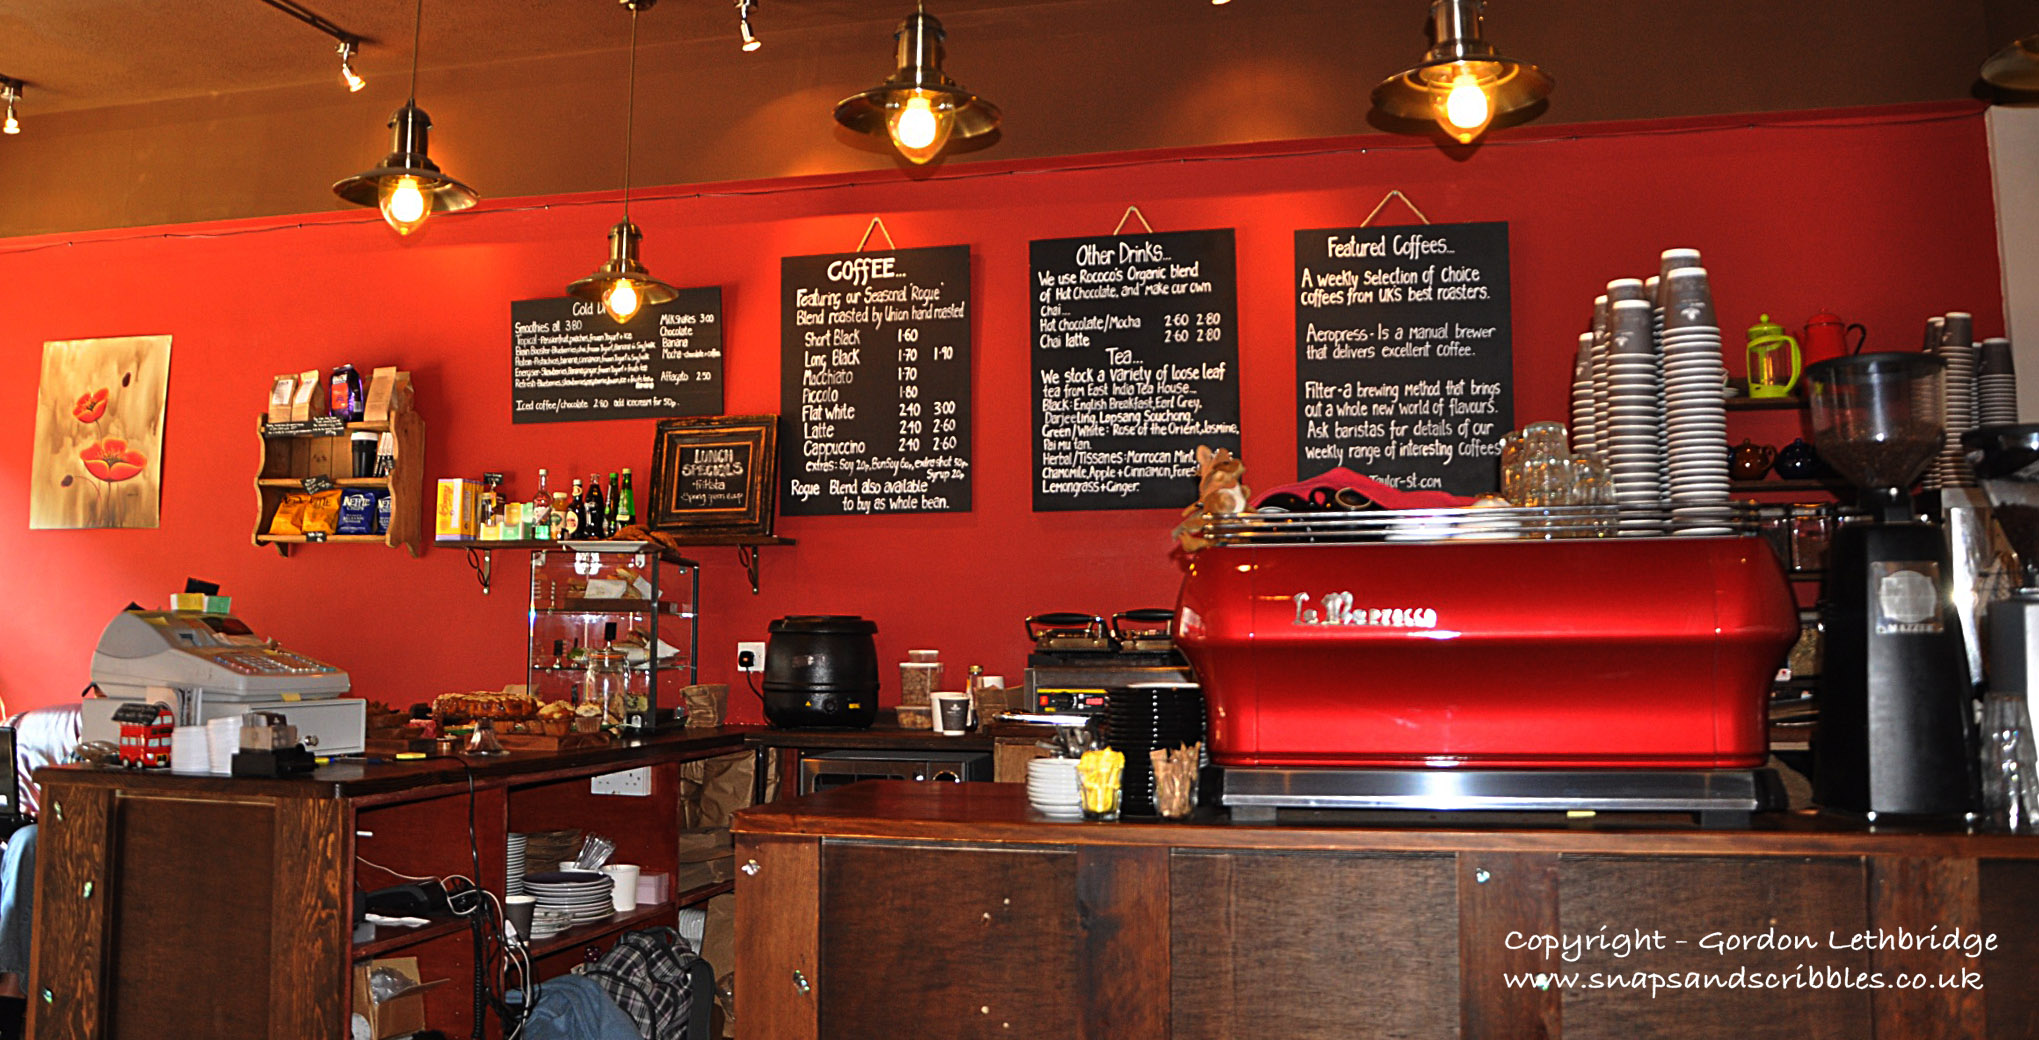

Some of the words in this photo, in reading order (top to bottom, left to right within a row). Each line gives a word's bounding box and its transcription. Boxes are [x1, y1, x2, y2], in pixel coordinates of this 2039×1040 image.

[1076, 244, 1115, 266] Other
[1327, 235, 1386, 258] Featured
[1038, 270, 1055, 286] We
[1058, 273, 1077, 285] use
[1080, 267, 1123, 284] Rococo's
[1127, 266, 1167, 286] Organic
[1170, 260, 1199, 279] blend
[1301, 267, 1313, 288] A
[1317, 269, 1358, 293] weekly
[1422, 264, 1435, 285] of
[796, 288, 841, 310] Featuring
[846, 291, 861, 304] our
[864, 286, 906, 304] Seasonal
[1039, 288, 1052, 304] of
[1055, 286, 1071, 300] Hot
[1121, 281, 1140, 297] and
[1171, 282, 1188, 294] our
[1189, 281, 1212, 294] own
[1347, 287, 1373, 306] from
[1408, 284, 1433, 302] best
[1437, 283, 1491, 301] roasters.
[572, 302, 593, 316] Cold
[797, 308, 824, 326] Blend
[828, 307, 869, 325] roasted
[872, 306, 882, 330] by
[885, 305, 909, 321] Union
[912, 303, 933, 320] hand
[934, 301, 965, 319] roasted
[660, 326, 694, 337] Chocolate
[1039, 318, 1056, 332] Hot
[1378, 322, 1389, 340] Is
[1394, 326, 1404, 340] a
[1455, 322, 1496, 338] brewer
[662, 338, 689, 348] Banana
[805, 329, 831, 347] Short
[833, 328, 860, 346] Black
[1039, 334, 1062, 348] Chai
[1065, 331, 1090, 347] latte
[1306, 343, 1328, 360] that
[1332, 343, 1375, 359] delivers
[1381, 341, 1431, 357] excellent
[805, 350, 826, 374] Long
[832, 348, 860, 366] Black
[803, 368, 853, 386] Macchiato
[1041, 369, 1060, 384] We
[1064, 367, 1094, 383] stock
[1097, 369, 1105, 382] a
[1156, 364, 1169, 386] of
[1171, 364, 1200, 381] loose
[1202, 361, 1226, 381] leaf
[803, 387, 839, 404] Piccolo
[1042, 384, 1061, 397] tea
[1087, 382, 1109, 396] East
[1112, 382, 1135, 396] India
[1135, 383, 1154, 395] Tea
[1356, 381, 1399, 403] brewing
[1446, 379, 1466, 395] that
[1471, 379, 1501, 400] brings
[516, 400, 534, 411] Iced
[802, 405, 823, 422] Flat
[825, 403, 855, 420] white
[1073, 397, 1107, 414] English
[1305, 401, 1322, 417] out
[1325, 403, 1333, 417] a
[1336, 401, 1368, 416] whole
[1372, 403, 1394, 416] new
[1399, 399, 1430, 415] world
[1432, 398, 1444, 416] of
[1449, 398, 1499, 416] flavours.
[1099, 410, 1142, 428] Lapsang
[1112, 423, 1136, 436] Rose
[1137, 422, 1148, 435] of
[1150, 420, 1167, 436] the
[804, 422, 834, 439] Latte
[1307, 420, 1329, 438] Ask
[1334, 420, 1385, 438] baristas
[1389, 420, 1408, 440] for
[1413, 419, 1453, 436] details
[1457, 418, 1471, 438] of
[1472, 422, 1494, 435] our
[694, 448, 734, 464] LUNCH
[803, 440, 866, 462] Cappuccino
[1305, 443, 1344, 467] weekly
[1348, 446, 1381, 465] range
[1384, 440, 1397, 460] of
[1400, 439, 1453, 465] interesting
[681, 462, 744, 477] SPECIALS
[839, 457, 855, 477] Soy
[926, 468, 950, 483] Syrup
[791, 479, 820, 502] Rogue
[829, 479, 858, 495] Blend
[861, 478, 881, 495] also
[883, 478, 928, 494] available
[842, 496, 854, 511] to
[857, 495, 871, 514] buy
[873, 497, 886, 510] as
[921, 494, 950, 509] bean.
